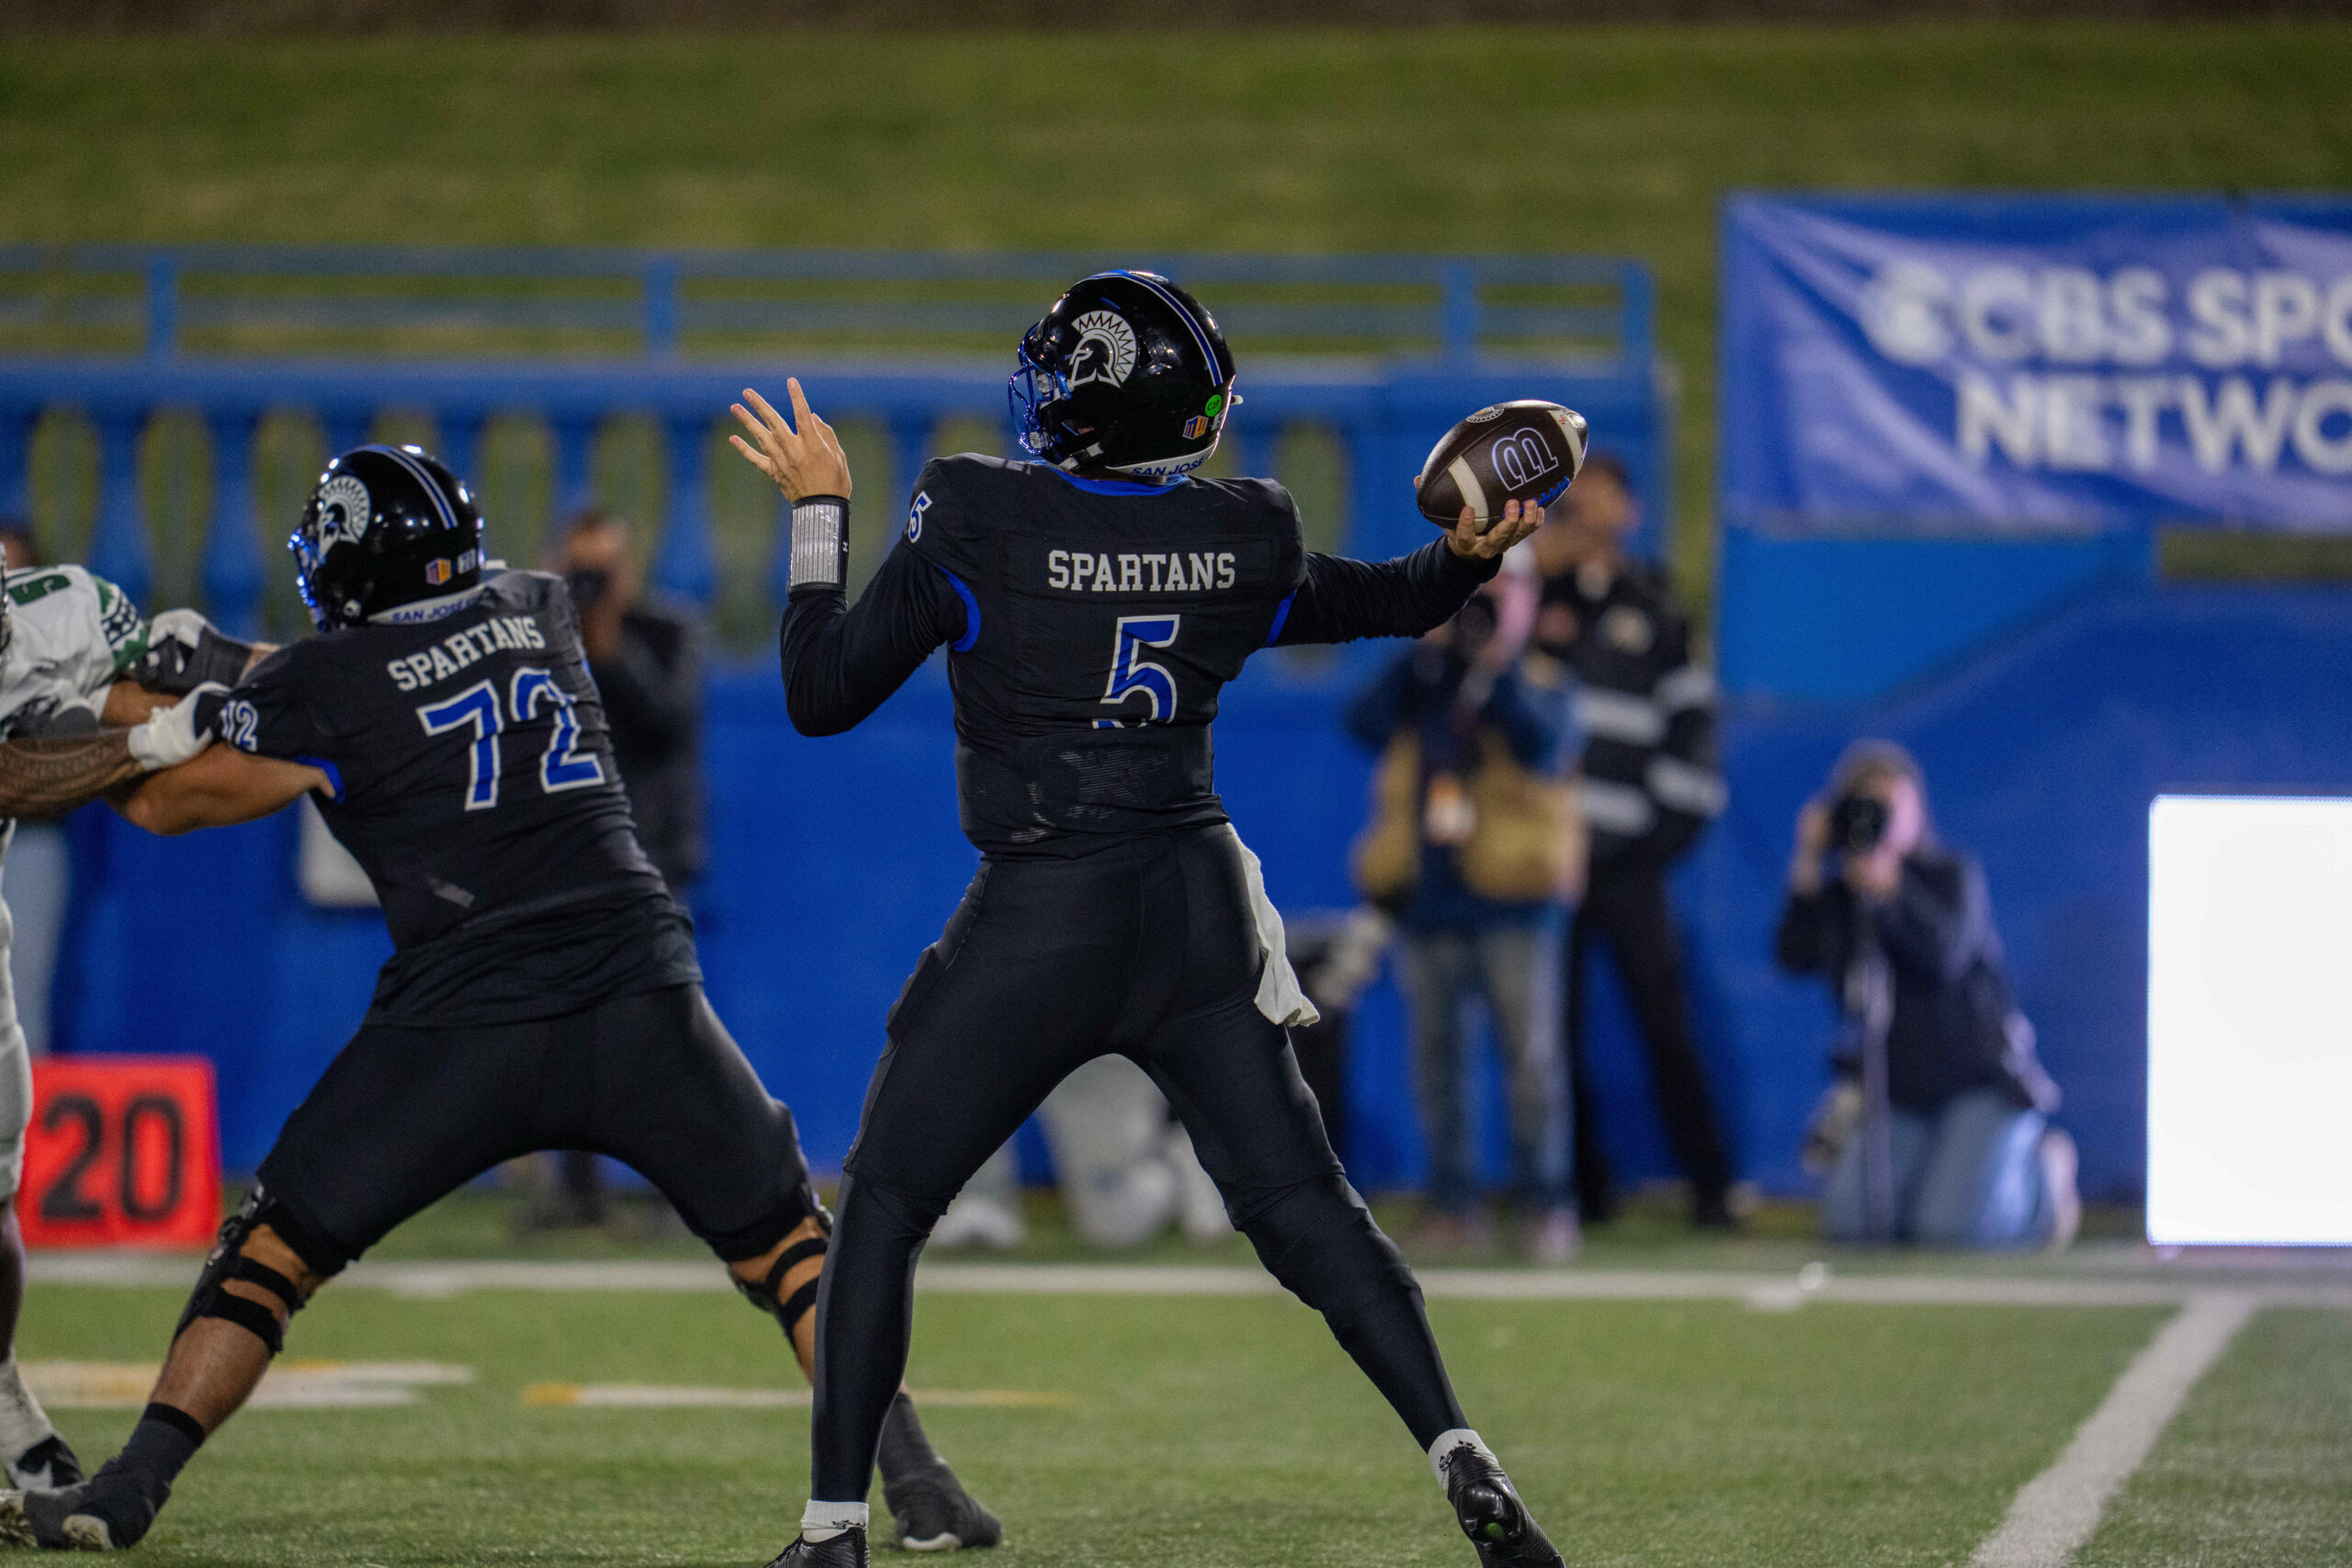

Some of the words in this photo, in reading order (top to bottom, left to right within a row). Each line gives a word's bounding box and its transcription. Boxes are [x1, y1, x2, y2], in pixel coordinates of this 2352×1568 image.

[1963, 264, 2170, 366] CBS
[1131, 466, 1167, 476] SAN
[908, 491, 933, 544] 5
[1048, 549, 1236, 592] SPARTANS
[387, 616, 546, 692] SPARTANS
[392, 611, 424, 623] SAN
[1091, 614, 1181, 728] 5
[415, 666, 605, 812] 72
[40, 1091, 184, 1222] 20
